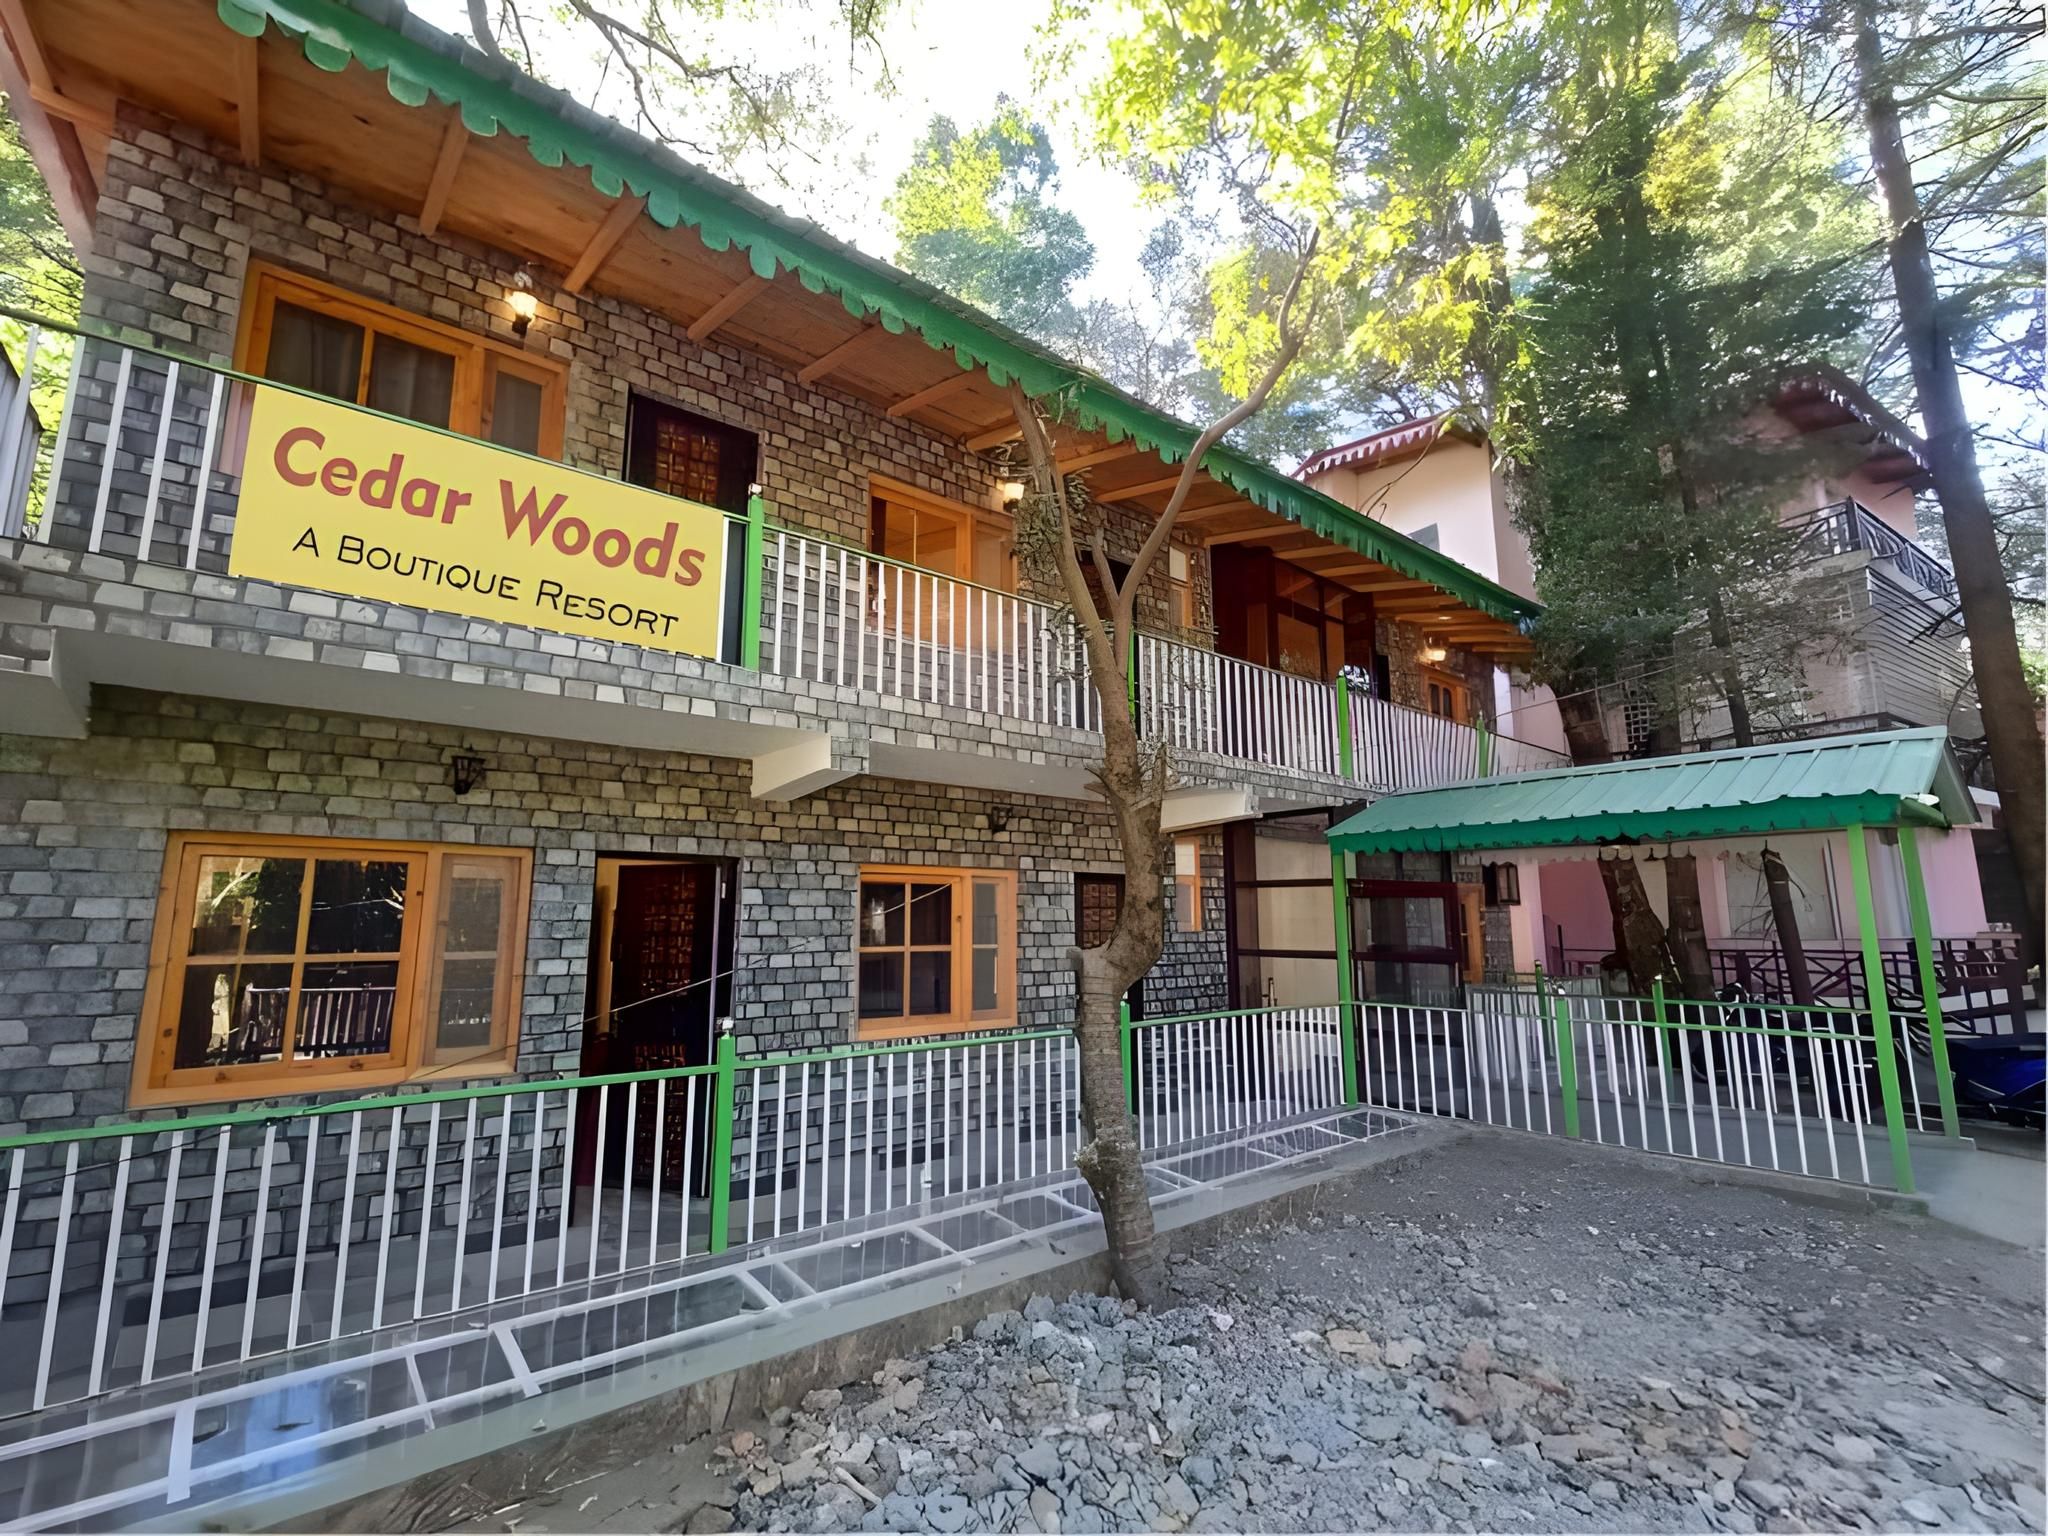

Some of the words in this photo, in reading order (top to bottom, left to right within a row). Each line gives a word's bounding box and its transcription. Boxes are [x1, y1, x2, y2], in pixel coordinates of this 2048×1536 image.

[274, 427, 471, 524] Cedar
[499, 479, 706, 585] Woods
[292, 527, 319, 558] A
